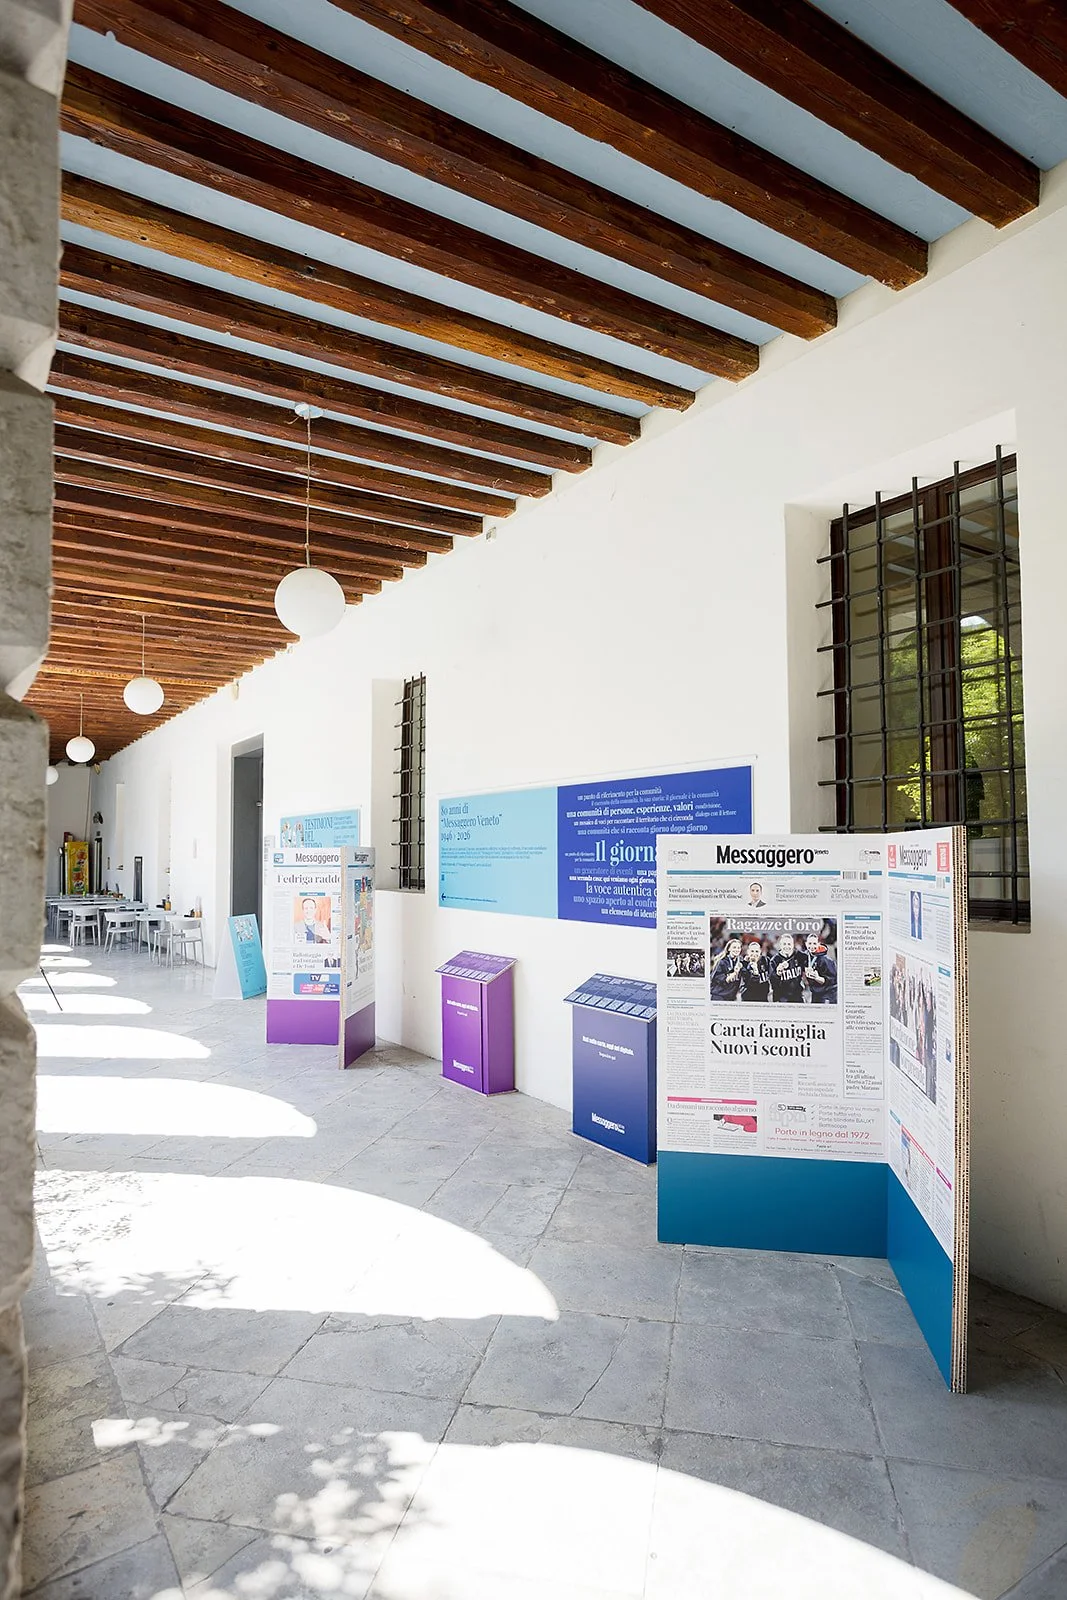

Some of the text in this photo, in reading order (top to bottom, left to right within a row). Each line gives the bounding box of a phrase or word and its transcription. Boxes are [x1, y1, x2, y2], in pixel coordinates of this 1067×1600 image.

[601, 791, 625, 799] riferimento
[639, 786, 662, 795] comunità
[697, 790, 719, 799] comunità
[449, 804, 461, 815] anni
[462, 803, 469, 814] di
[577, 807, 603, 818] comunità
[603, 807, 610, 816] di
[610, 807, 636, 819] persone,
[636, 803, 673, 816] esperienze,
[673, 801, 694, 812] valori
[305, 817, 333, 830] TESTIMONI
[639, 815, 659, 823] territorio
[673, 813, 694, 821] circonda
[457, 830, 470, 840] 2026
[587, 826, 610, 835] comunità
[611, 826, 620, 834] che
[621, 826, 625, 834] si
[626, 826, 649, 834] racconta
[650, 825, 669, 834] giorno
[670, 824, 686, 834] dopo
[687, 824, 708, 833] giorno
[296, 853, 340, 864] Messaggero
[596, 840, 606, 862] Il
[610, 839, 657, 867] giorn
[716, 845, 815, 868] Messaggero
[900, 845, 928, 870] Messaggero
[586, 882, 592, 893] la
[594, 885, 612, 895] voce
[613, 884, 652, 897] autentica
[586, 895, 605, 905] spazio
[606, 897, 627, 906] aperto
[627, 898, 633, 906] al
[609, 908, 633, 916] elemento
[634, 909, 639, 917] di
[727, 919, 820, 933] Ragazze d'oro
[711, 1022, 755, 1037] Carta
[759, 1023, 826, 1042] famiglia
[711, 1040, 811, 1057] Nuovi sconti
[775, 1128, 797, 1136] Porte
[810, 1129, 833, 1139] legno
[835, 1130, 848, 1139] dal
[851, 1131, 870, 1139] 1972
